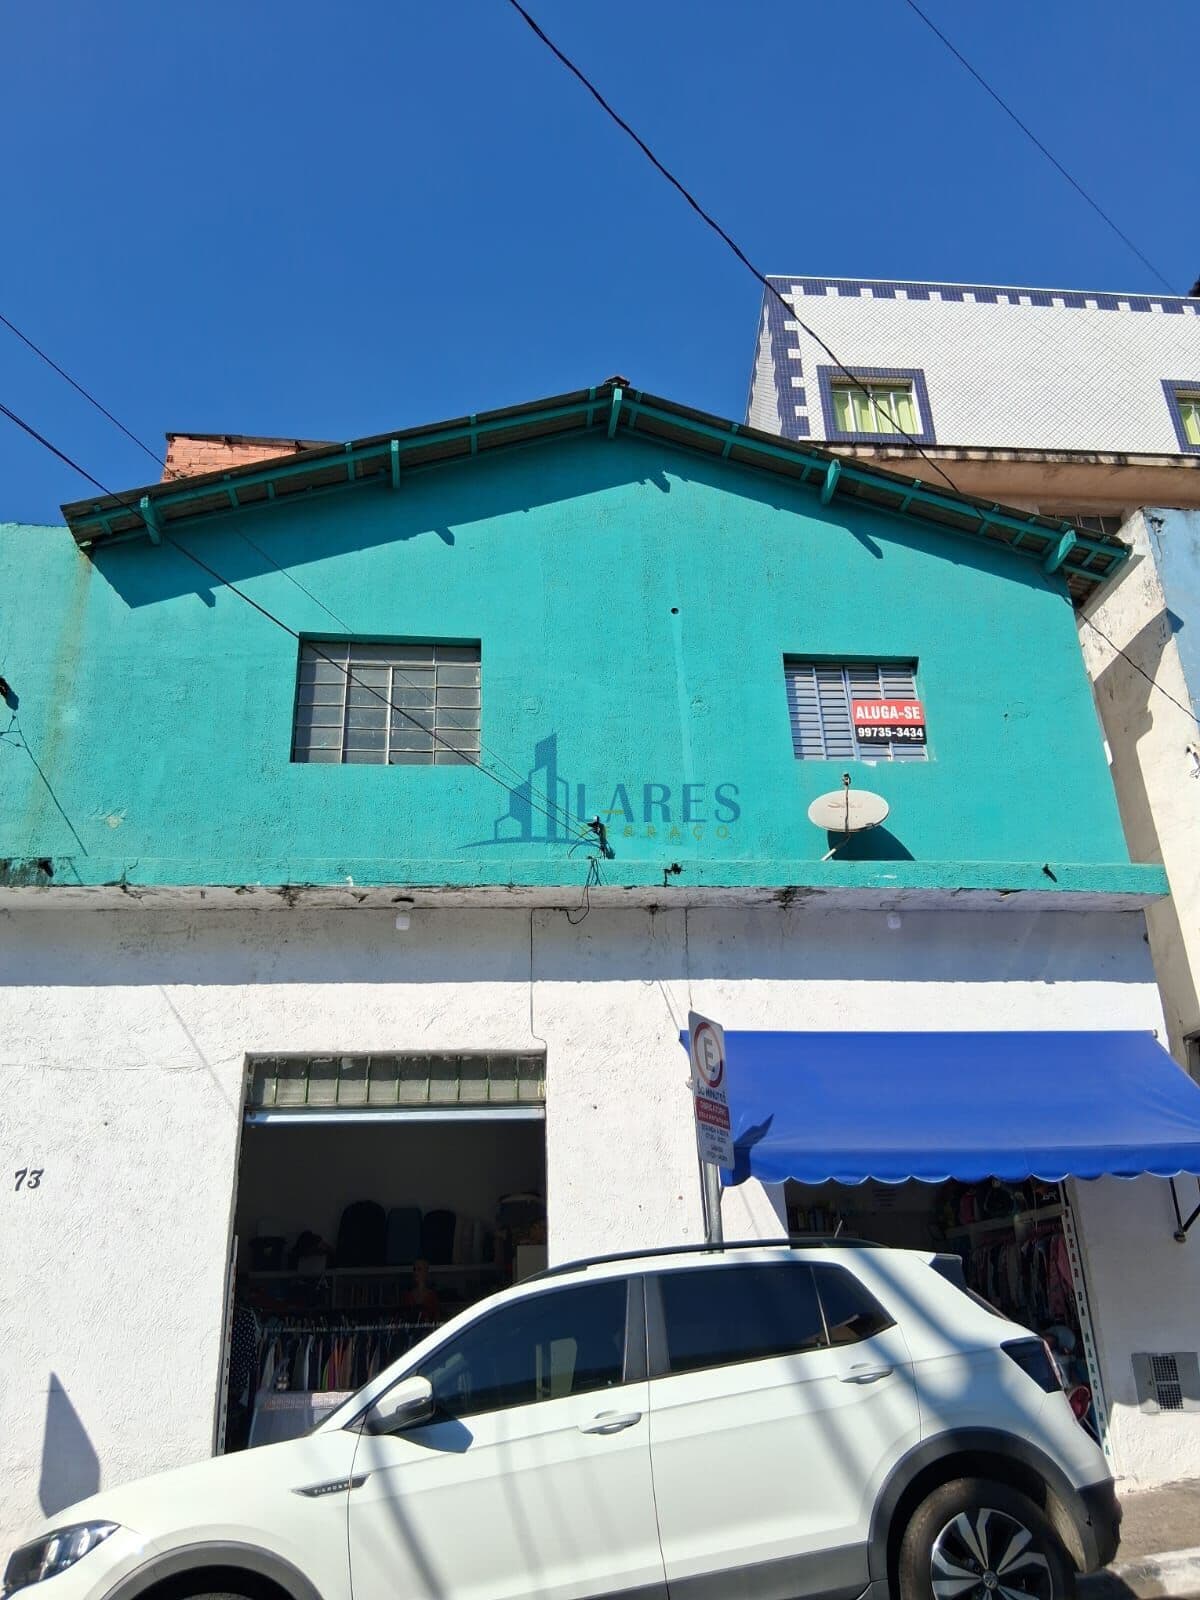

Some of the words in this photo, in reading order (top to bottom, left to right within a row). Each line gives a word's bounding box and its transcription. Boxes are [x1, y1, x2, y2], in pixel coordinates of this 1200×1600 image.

[856, 705, 921, 720] ALUGA-SE
[858, 727, 924, 737] 99735-3434
[703, 1036, 716, 1072] E
[15, 1167, 45, 1191] 73
